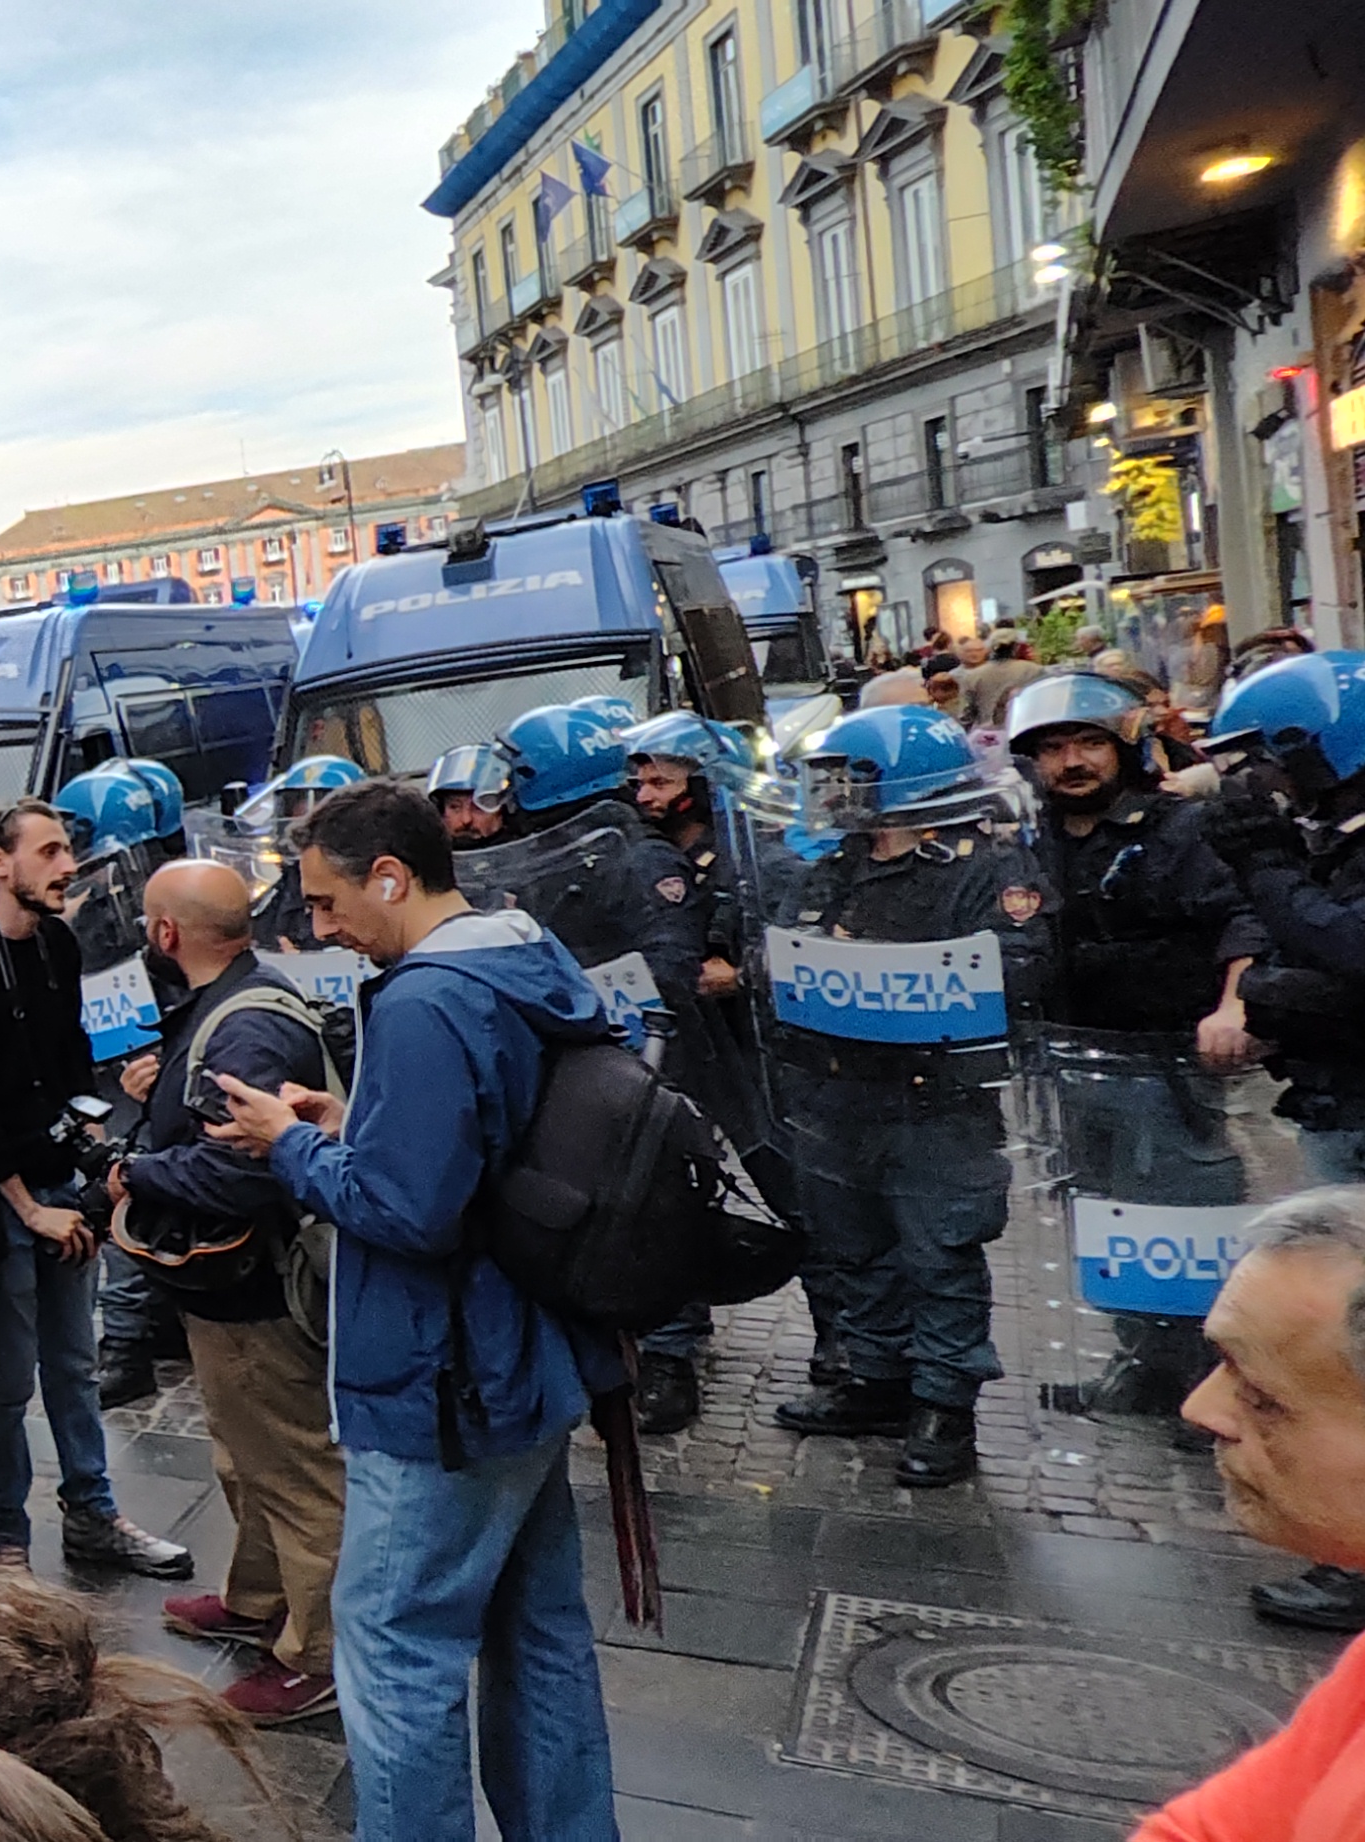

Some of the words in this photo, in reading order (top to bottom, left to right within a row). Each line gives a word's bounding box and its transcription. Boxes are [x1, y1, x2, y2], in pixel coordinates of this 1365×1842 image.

[360, 569, 583, 622] POLIZIA
[793, 964, 977, 1012] POLIZIA
[1107, 1236, 1251, 1281] POLI
